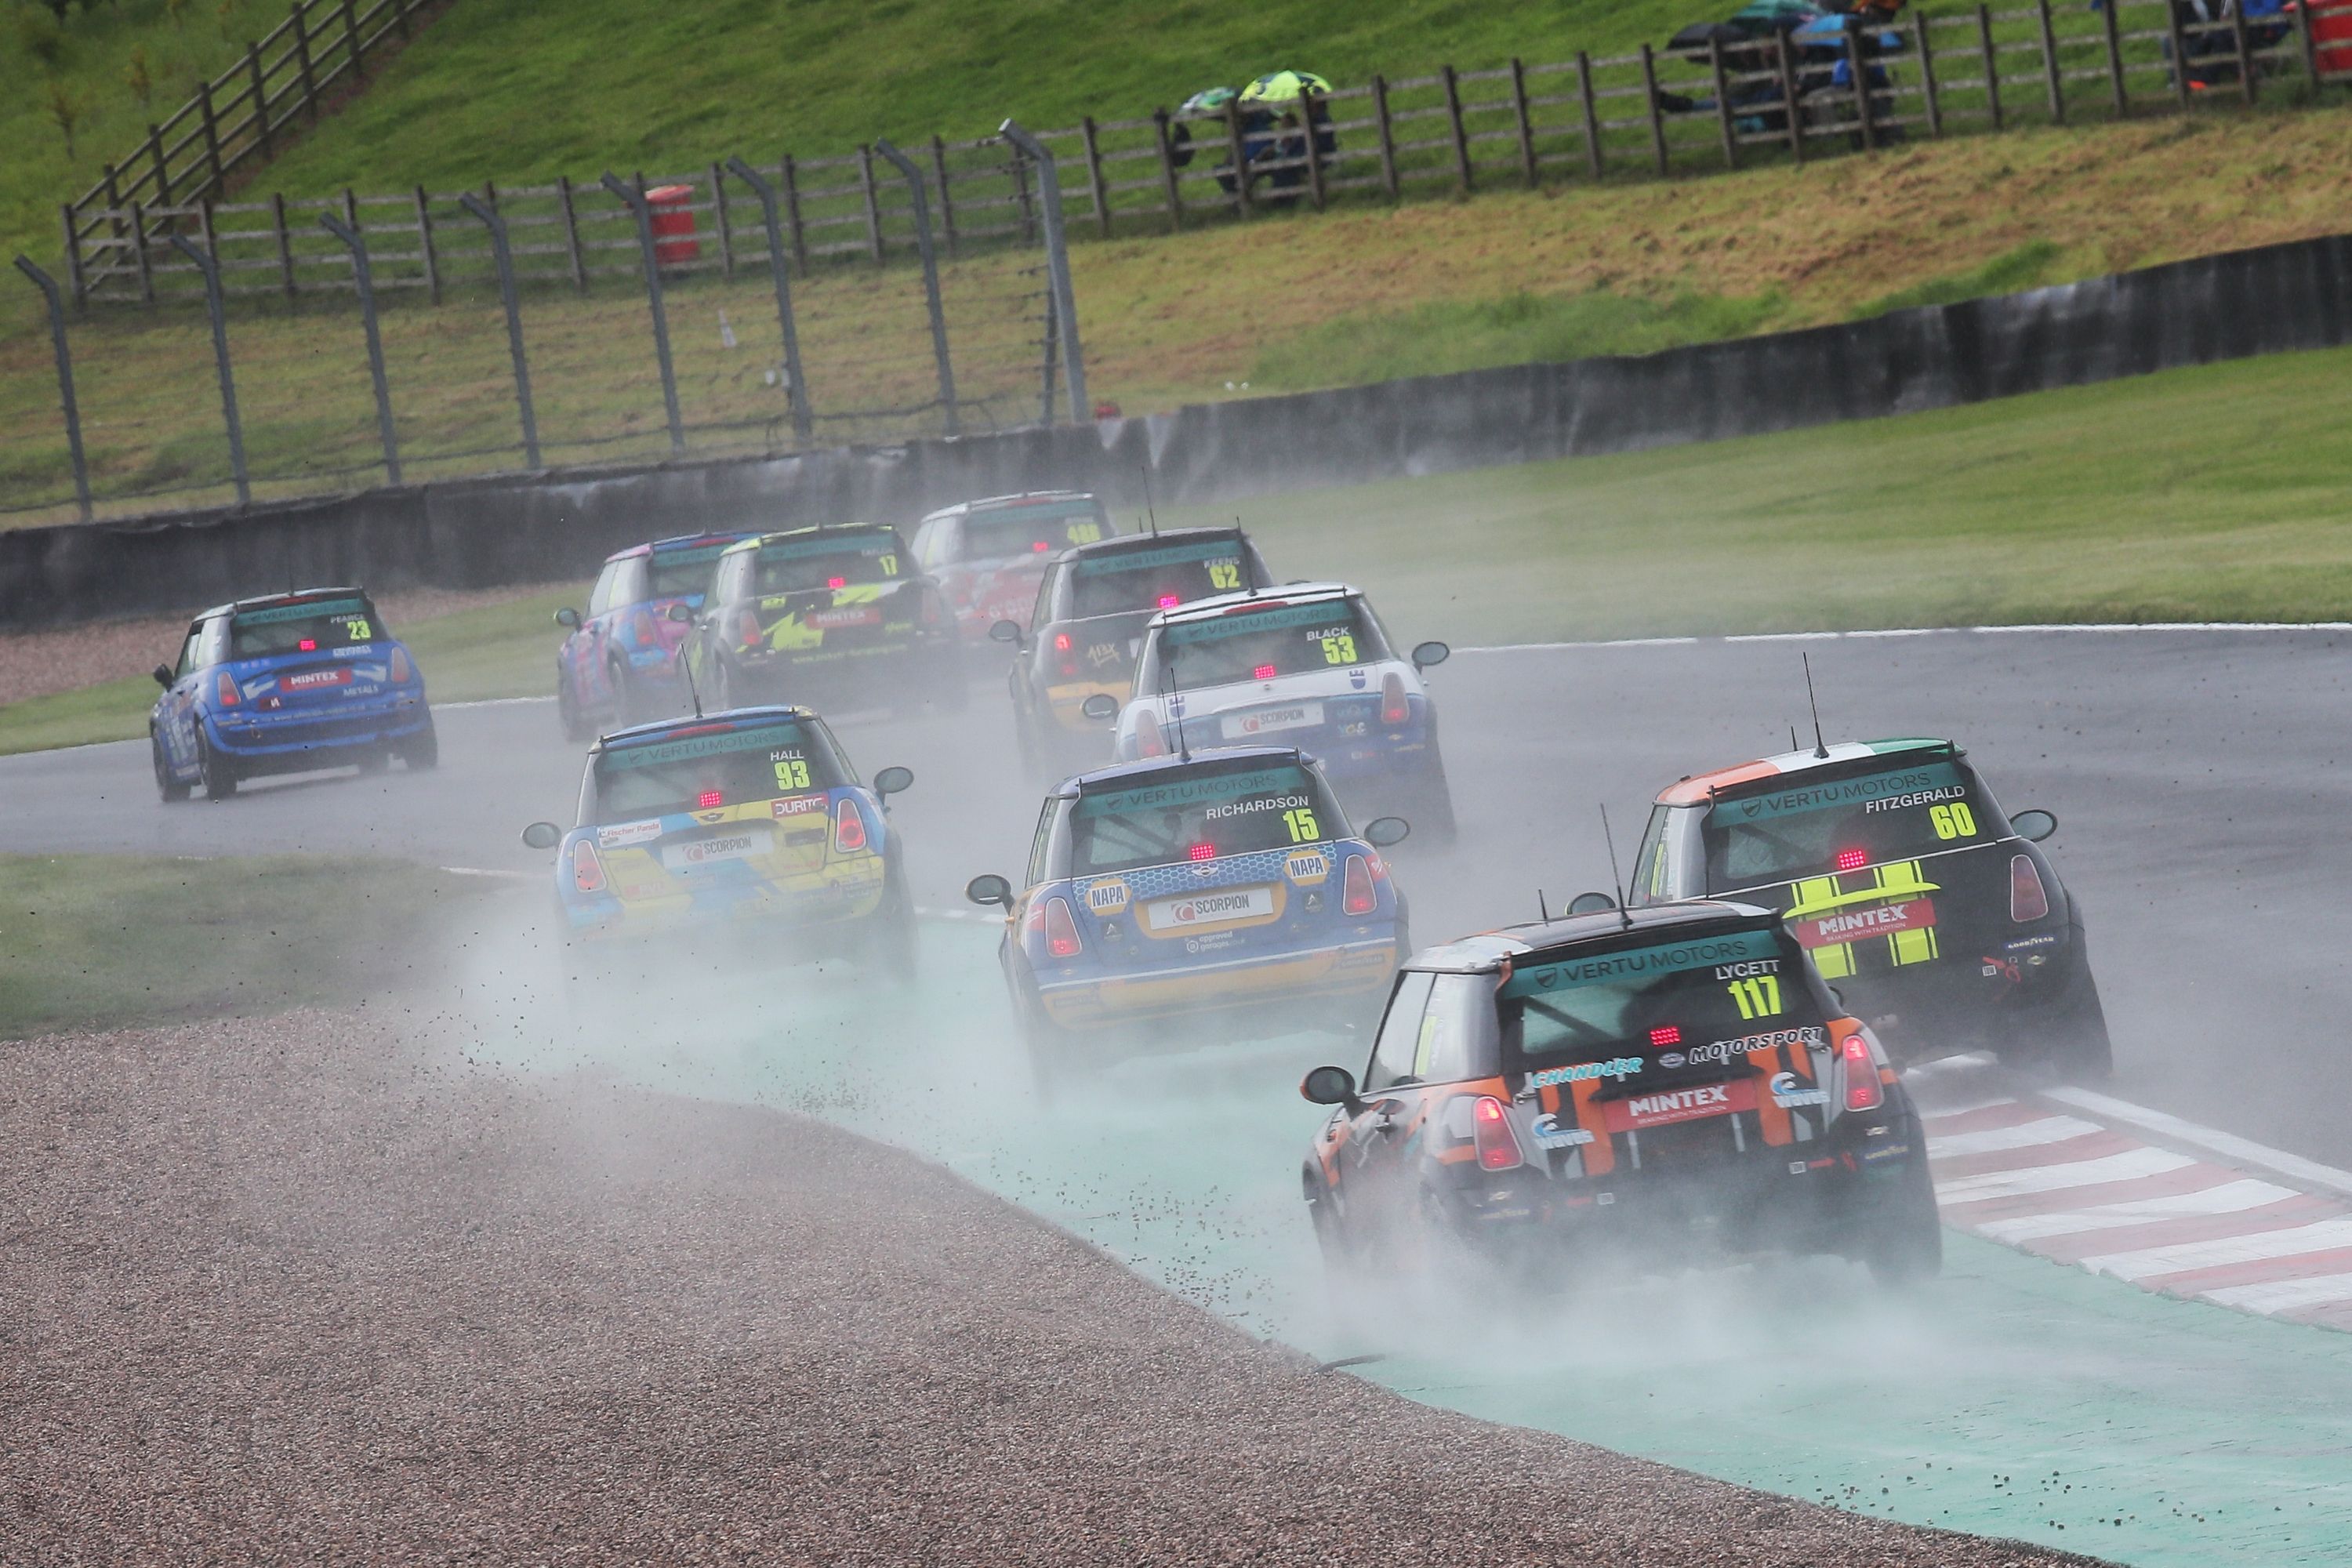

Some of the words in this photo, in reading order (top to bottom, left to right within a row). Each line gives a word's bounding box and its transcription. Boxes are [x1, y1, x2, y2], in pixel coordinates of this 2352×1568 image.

[879, 555, 898, 576] 17
[1210, 564, 1240, 589] 62
[347, 620, 372, 641] 23
[1207, 619, 1260, 635] VERTU
[1265, 608, 1330, 627] MOTORS
[1306, 626, 1350, 641] BLACK
[1321, 636, 1358, 664] 53
[291, 671, 339, 685] MINTEX
[1260, 709, 1305, 725] SCORPION
[648, 739, 706, 760] VERTU
[709, 731, 779, 750] MOTORS
[771, 750, 804, 762] HALL
[774, 760, 811, 791] 93
[1130, 785, 1194, 804] VERTU
[1198, 774, 1277, 795] MOTORS
[1767, 787, 1839, 811] VERTU
[1844, 772, 1931, 798] MOTORS
[1865, 786, 1965, 815] FITZGERALD
[1206, 796, 1309, 820] RICHARDSON
[607, 826, 635, 837] Fischer
[637, 822, 659, 833] Panda
[1282, 808, 1320, 843] 15
[1929, 801, 1977, 840] 60
[704, 837, 753, 855] SCORPION
[1290, 857, 1323, 877] NAPA
[1091, 886, 1124, 907] NAPA
[1196, 895, 1250, 915] SCORPION
[1818, 904, 1907, 935] MINTEX
[1854, 929, 1871, 938] WITH
[1872, 923, 1906, 934] TRADITION
[1199, 931, 1232, 943] approved
[2008, 936, 2054, 949] GOODYEAR
[1563, 955, 1646, 982] VERTU
[1650, 941, 1748, 968] MOTORS
[1715, 960, 1780, 980] LYCETT
[1727, 975, 1782, 1020] 117
[1532, 1056, 1644, 1089] CHANDLER
[1689, 1026, 1823, 1065] MOTORSPORT
[1628, 1085, 1730, 1116] MINTEX
